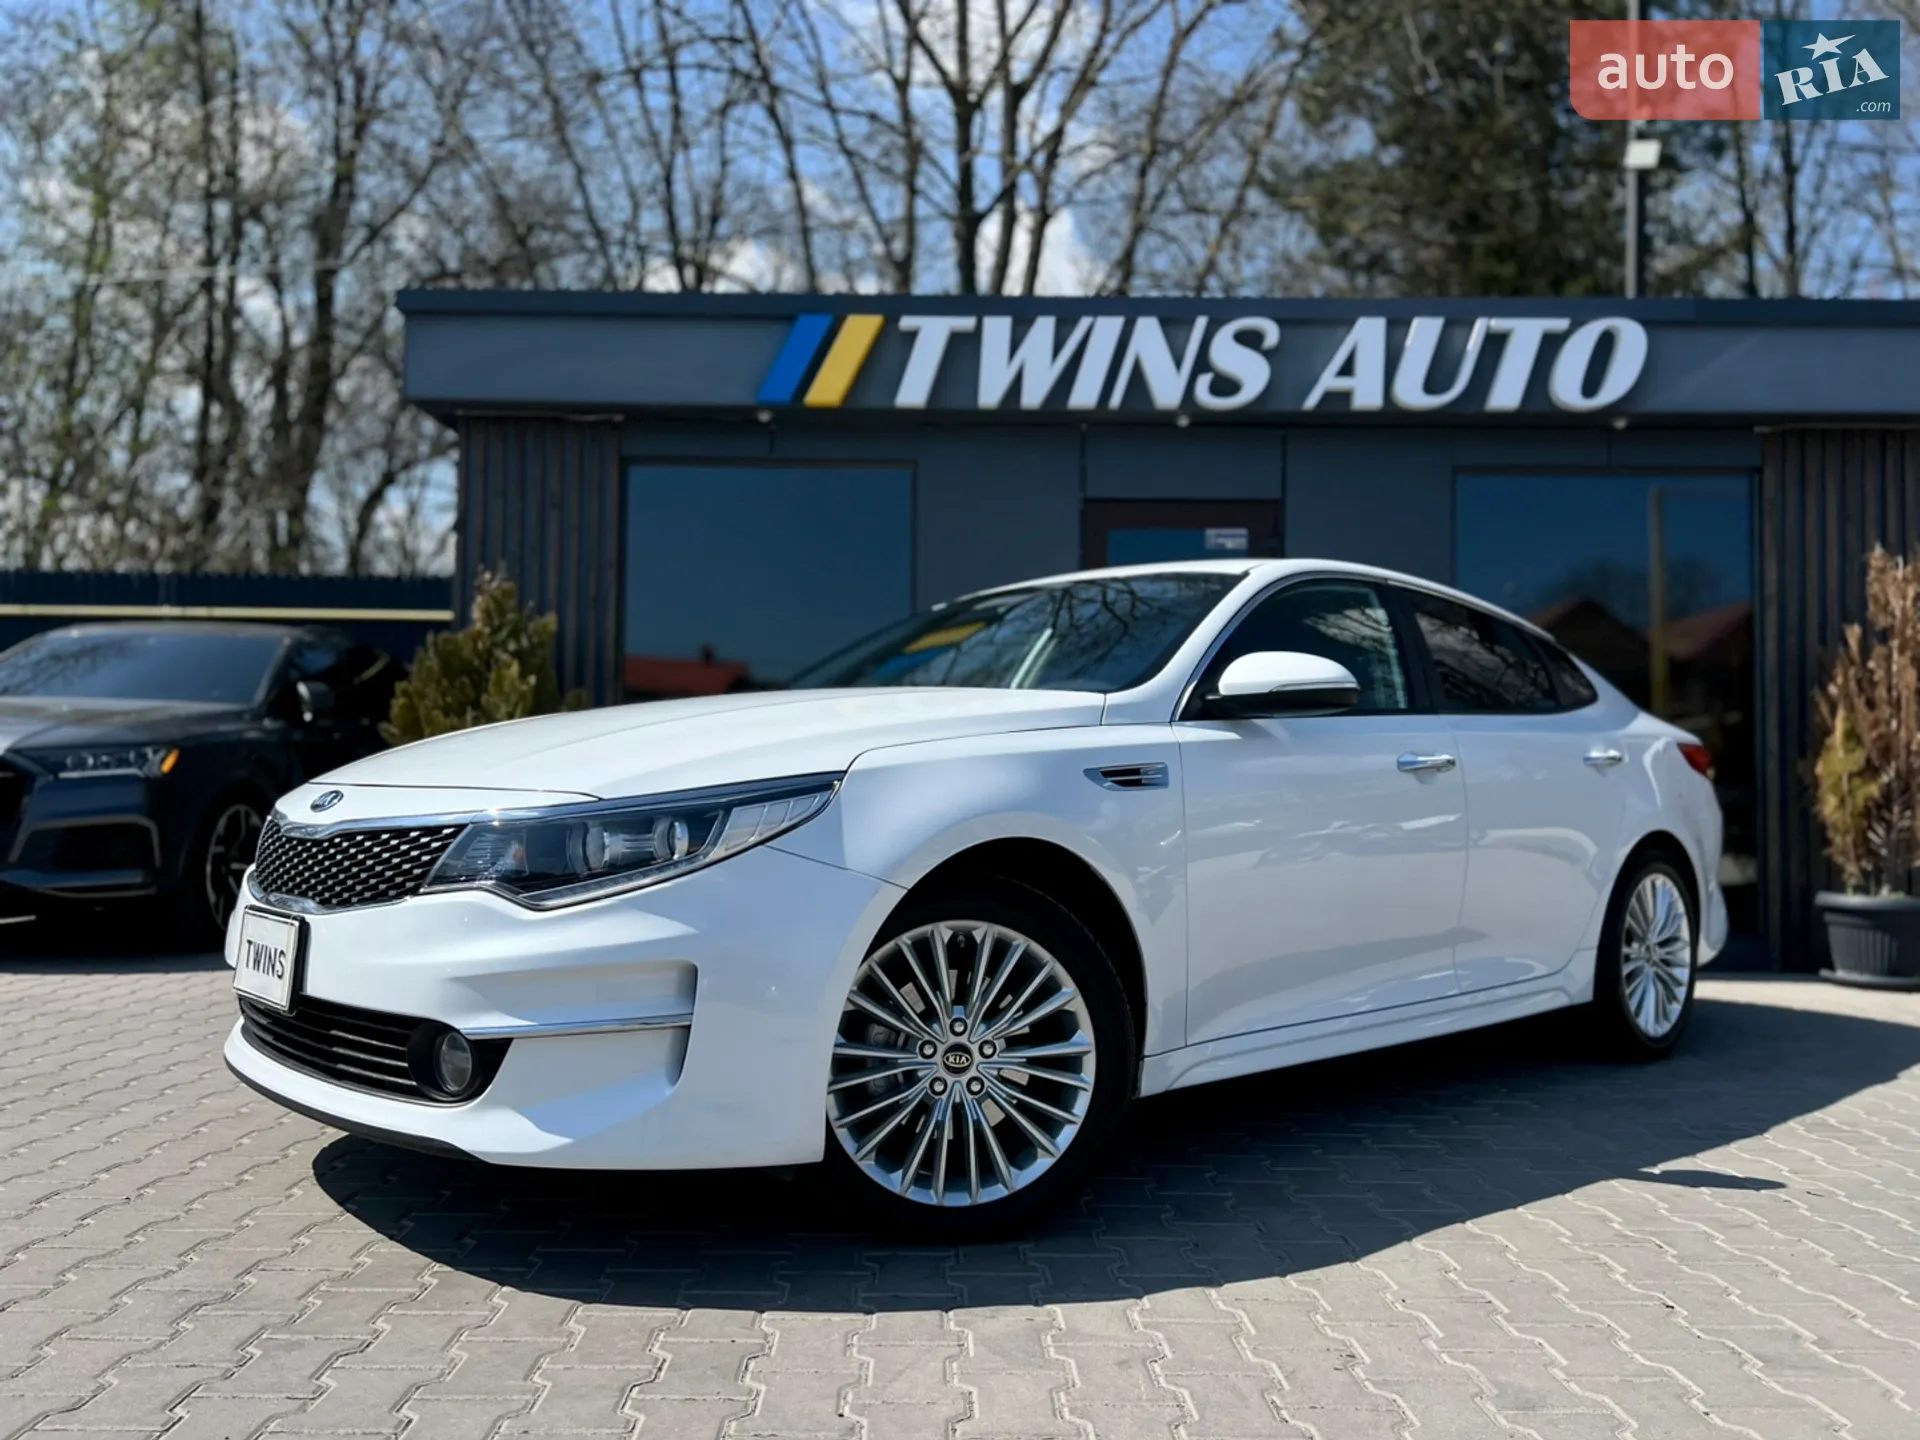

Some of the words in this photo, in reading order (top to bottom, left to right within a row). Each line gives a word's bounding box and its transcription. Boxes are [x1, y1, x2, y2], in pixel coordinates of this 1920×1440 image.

[894, 314, 1281, 412] TWINS
[1302, 316, 1649, 412] AUTO
[246, 938, 287, 980] TWINS
[948, 1055, 967, 1064] KIA
